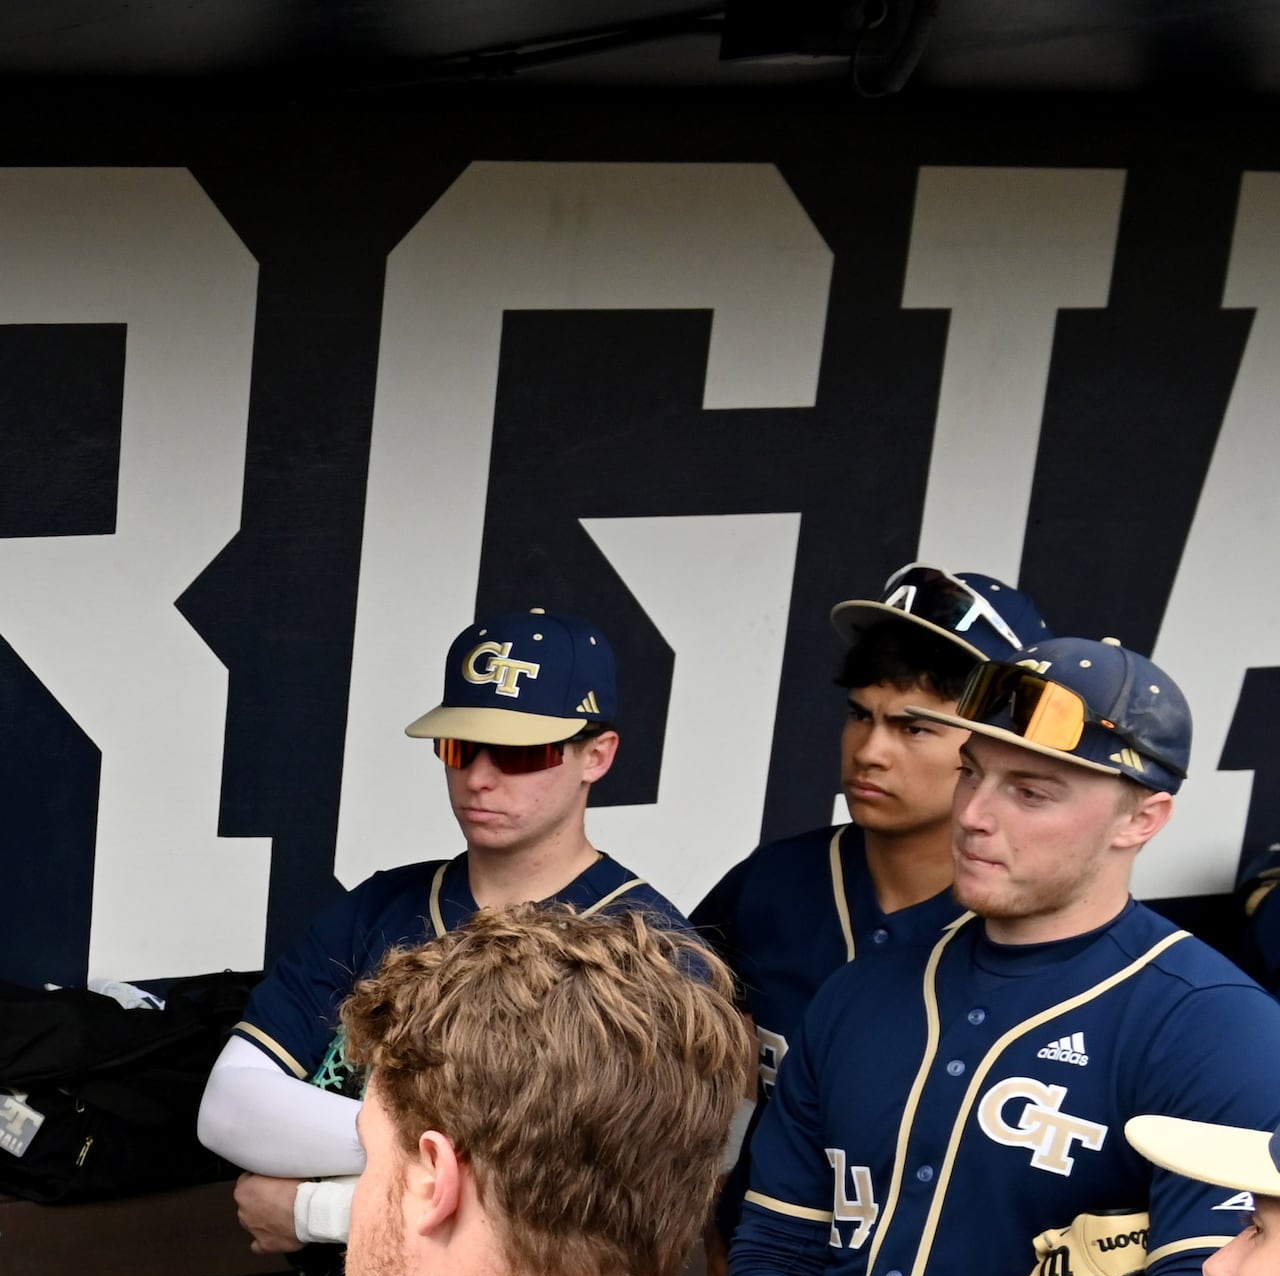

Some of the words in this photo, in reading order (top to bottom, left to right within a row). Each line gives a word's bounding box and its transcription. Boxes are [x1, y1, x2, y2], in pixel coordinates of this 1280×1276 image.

[461, 640, 541, 698] GT
[1036, 1047, 1089, 1067] adidas
[977, 1076, 1109, 1177] GT
